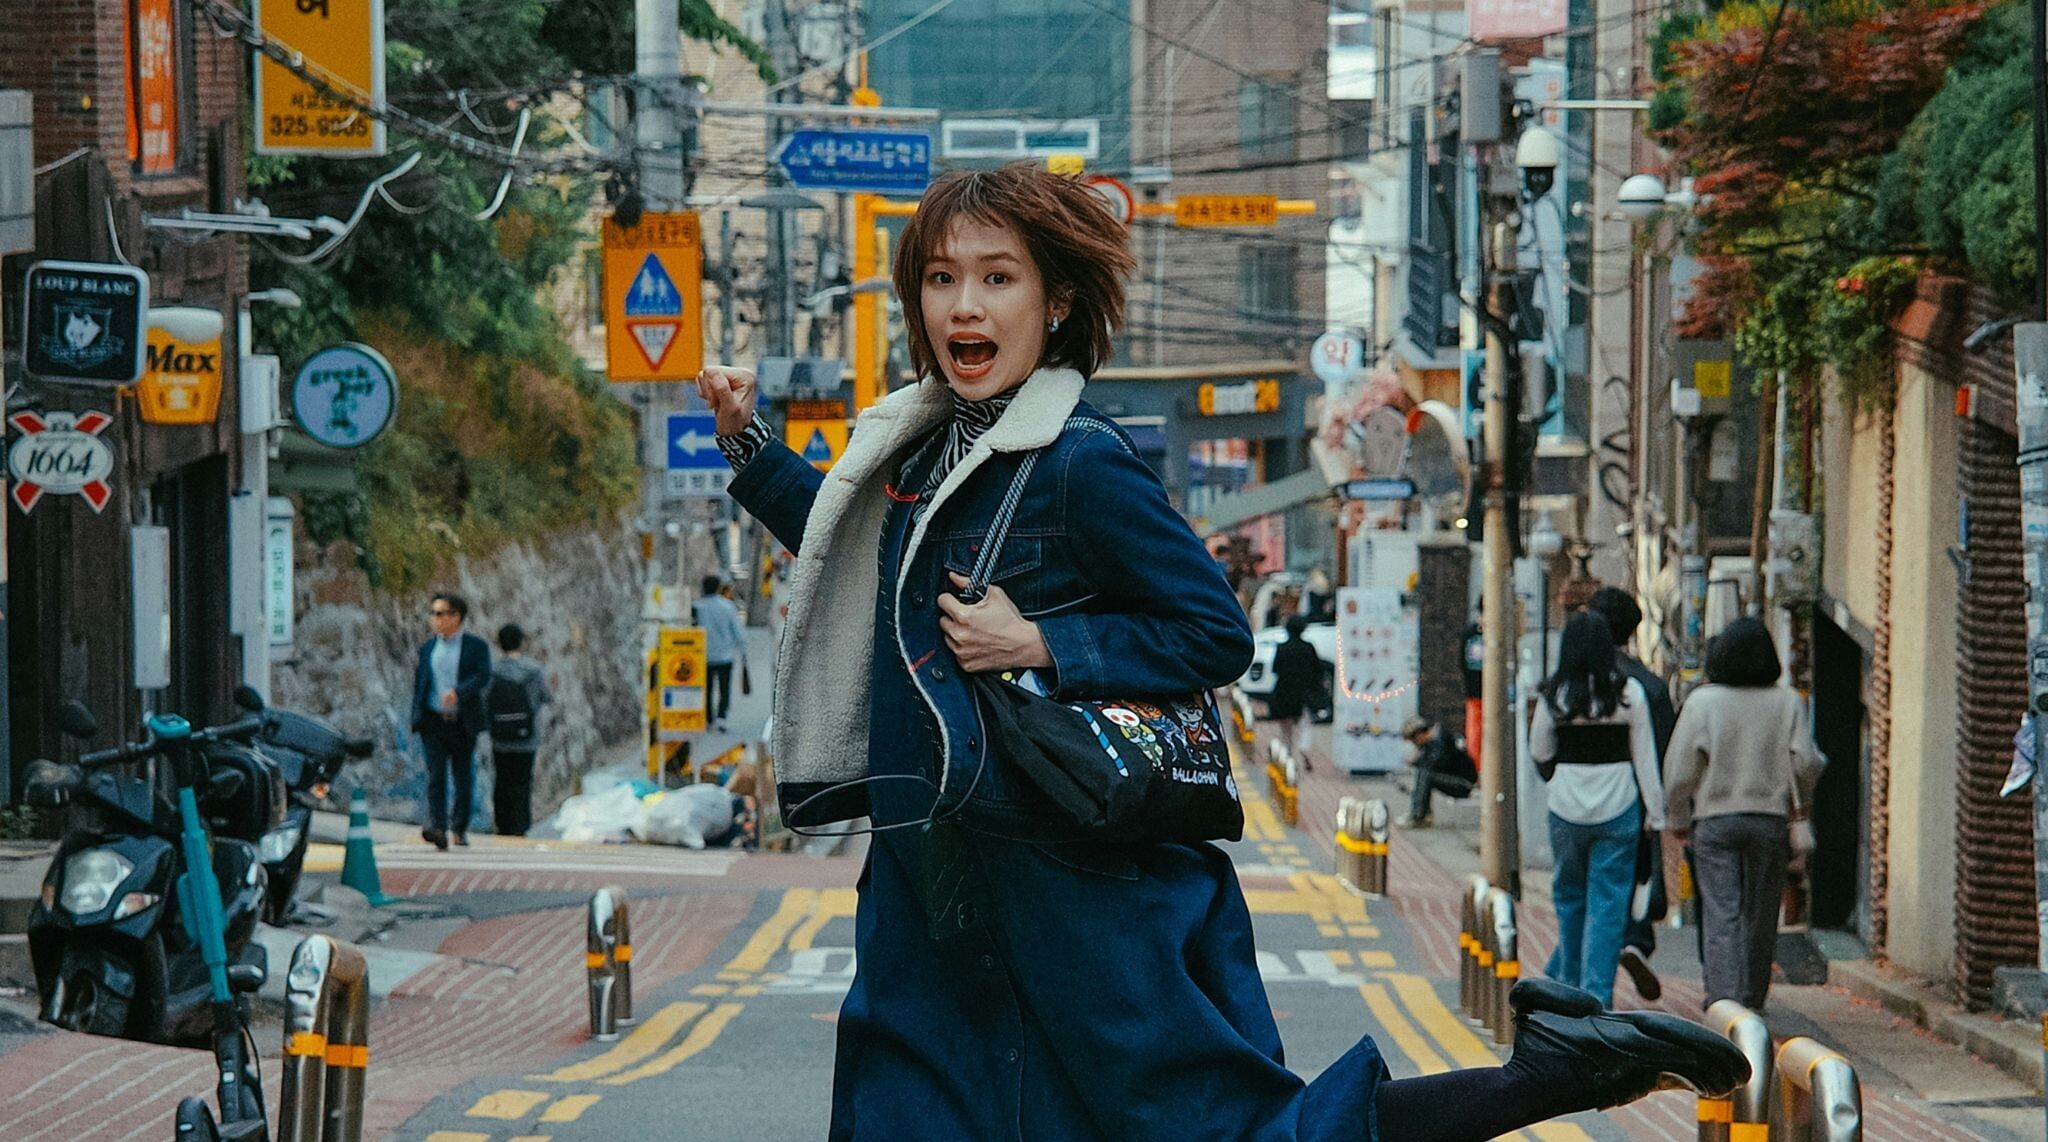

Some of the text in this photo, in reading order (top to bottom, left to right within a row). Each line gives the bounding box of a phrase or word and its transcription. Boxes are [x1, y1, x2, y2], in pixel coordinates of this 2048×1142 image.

[34, 275, 136, 297] LOUP BLANC
[146, 344, 216, 374] Max
[27, 446, 94, 477] 1664
